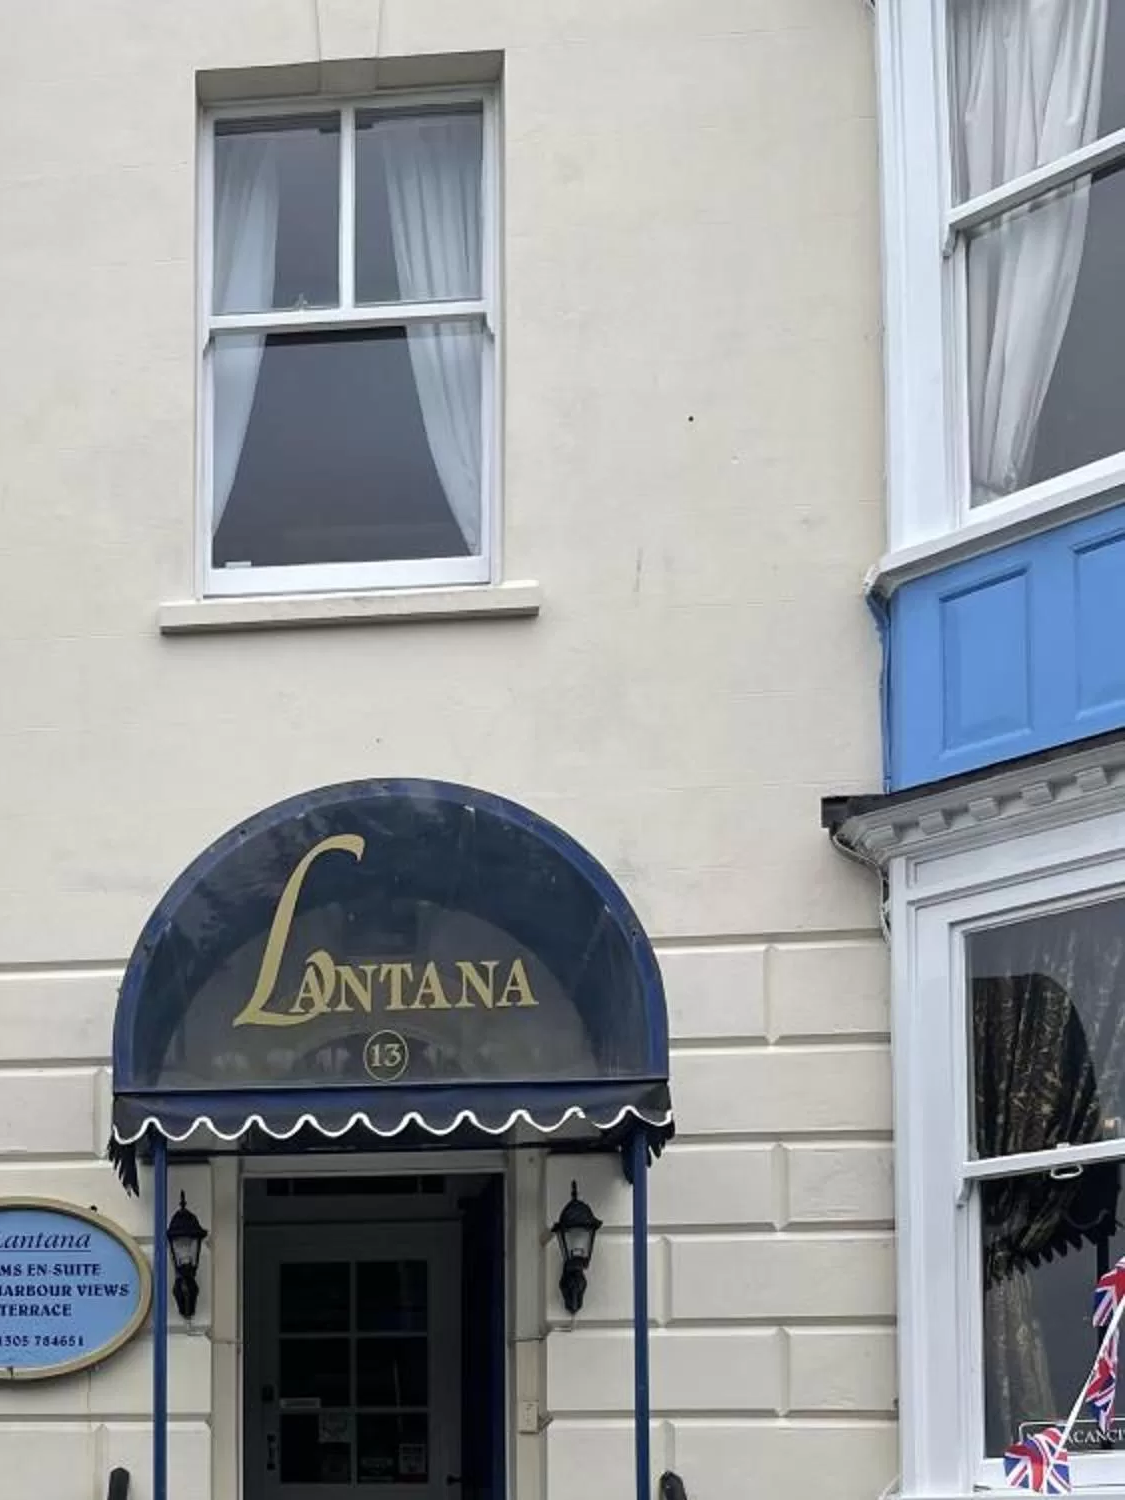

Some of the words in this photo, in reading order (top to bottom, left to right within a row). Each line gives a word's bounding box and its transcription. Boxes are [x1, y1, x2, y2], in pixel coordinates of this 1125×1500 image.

[370, 1043, 403, 1068] 13
[77, 1283, 130, 1297] VIEWS
[0, 1303, 72, 1317] TERRACE
